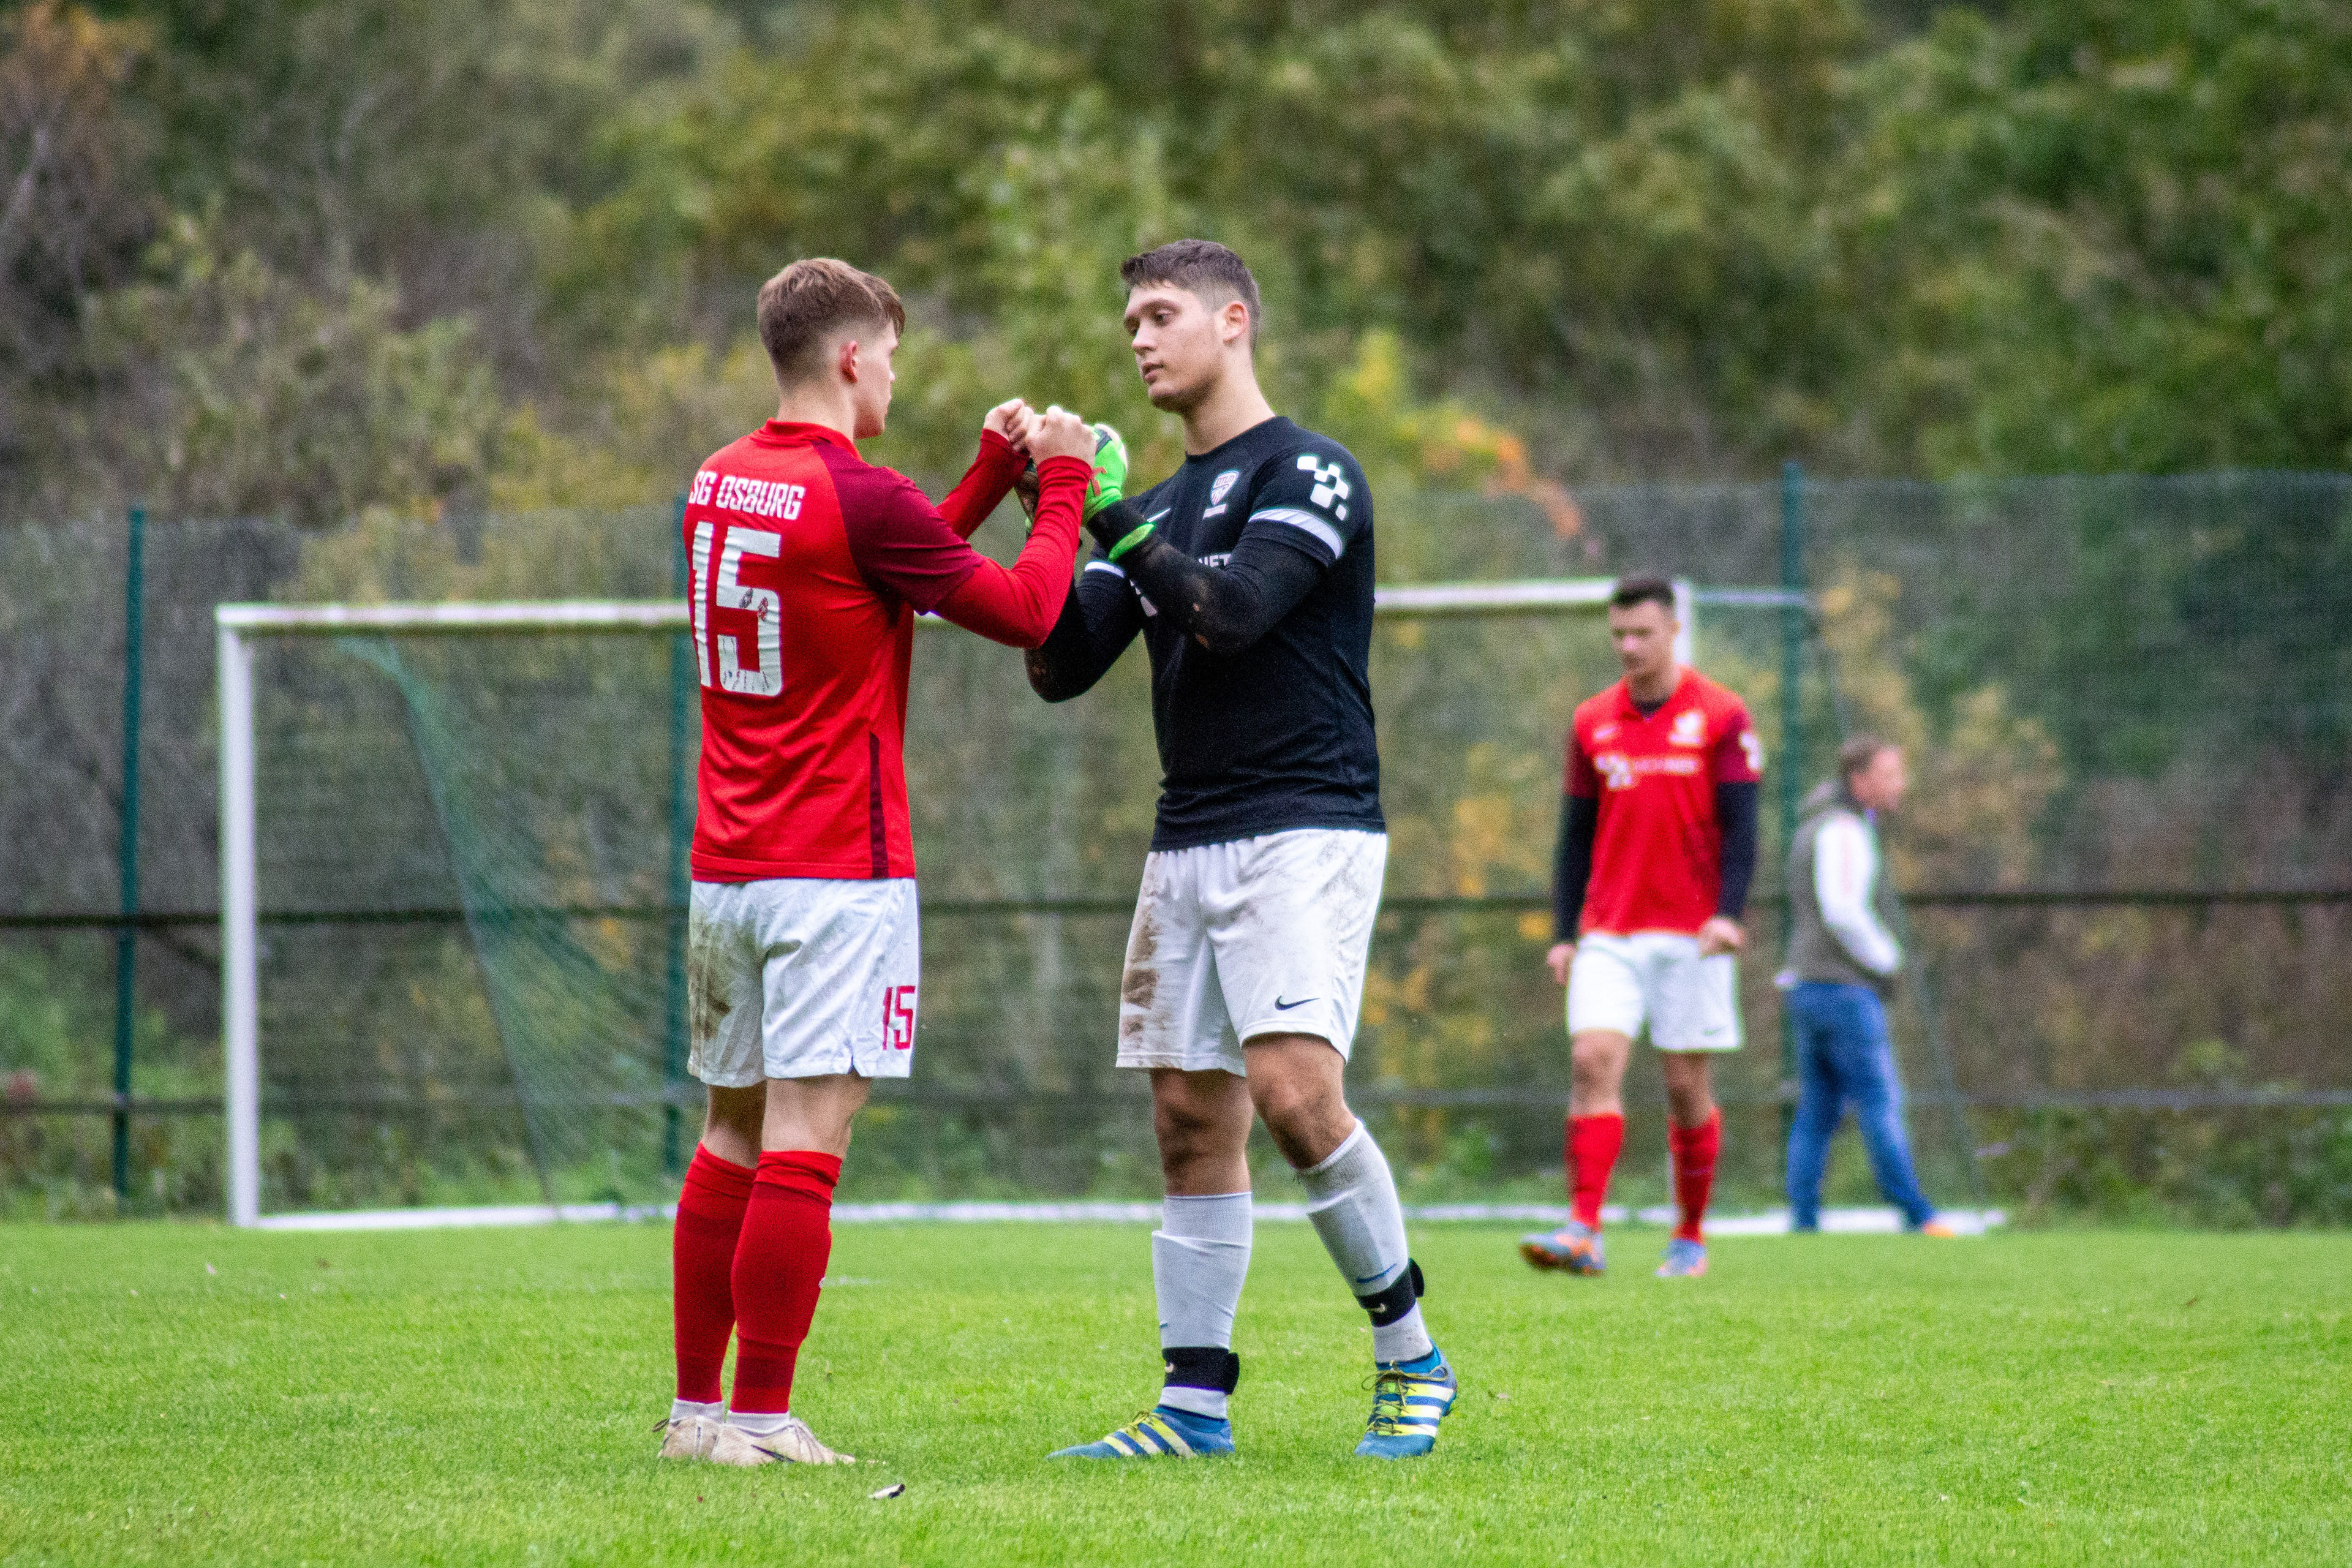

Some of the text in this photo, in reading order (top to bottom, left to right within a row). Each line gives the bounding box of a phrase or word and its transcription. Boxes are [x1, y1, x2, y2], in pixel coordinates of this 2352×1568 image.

[688, 471, 806, 520] SG OSBURG
[692, 521, 784, 697] 15
[882, 986, 916, 1051] 15
